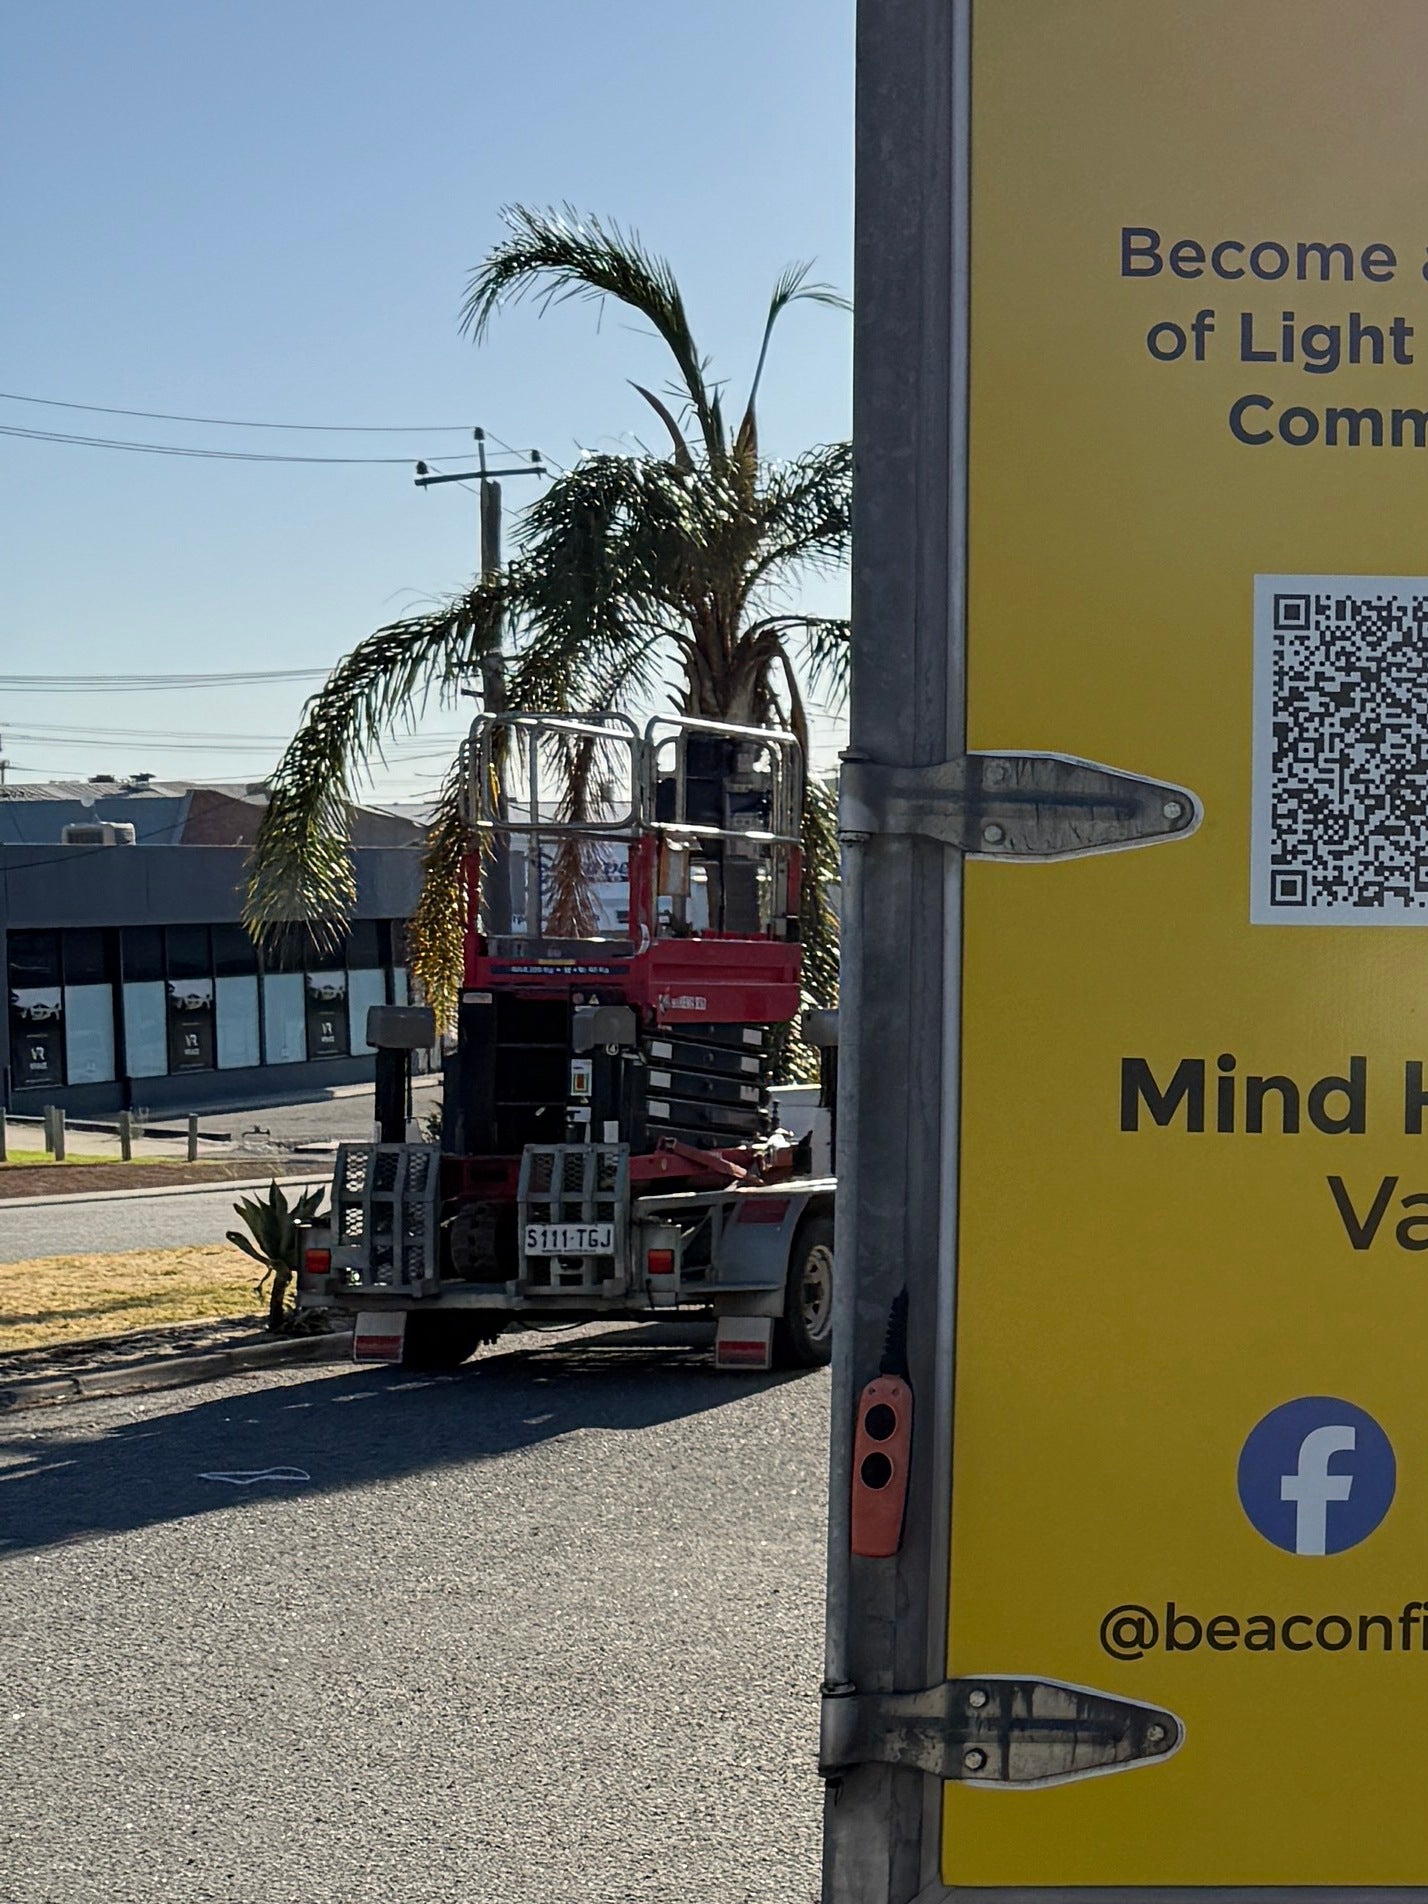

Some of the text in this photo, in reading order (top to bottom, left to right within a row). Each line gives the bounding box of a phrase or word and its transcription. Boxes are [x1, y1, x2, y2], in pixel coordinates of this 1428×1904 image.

[1121, 227, 1397, 283] Become
[1146, 309, 1215, 361] of
[1239, 311, 1414, 374] Light
[1120, 1053, 1367, 1135] Mind
